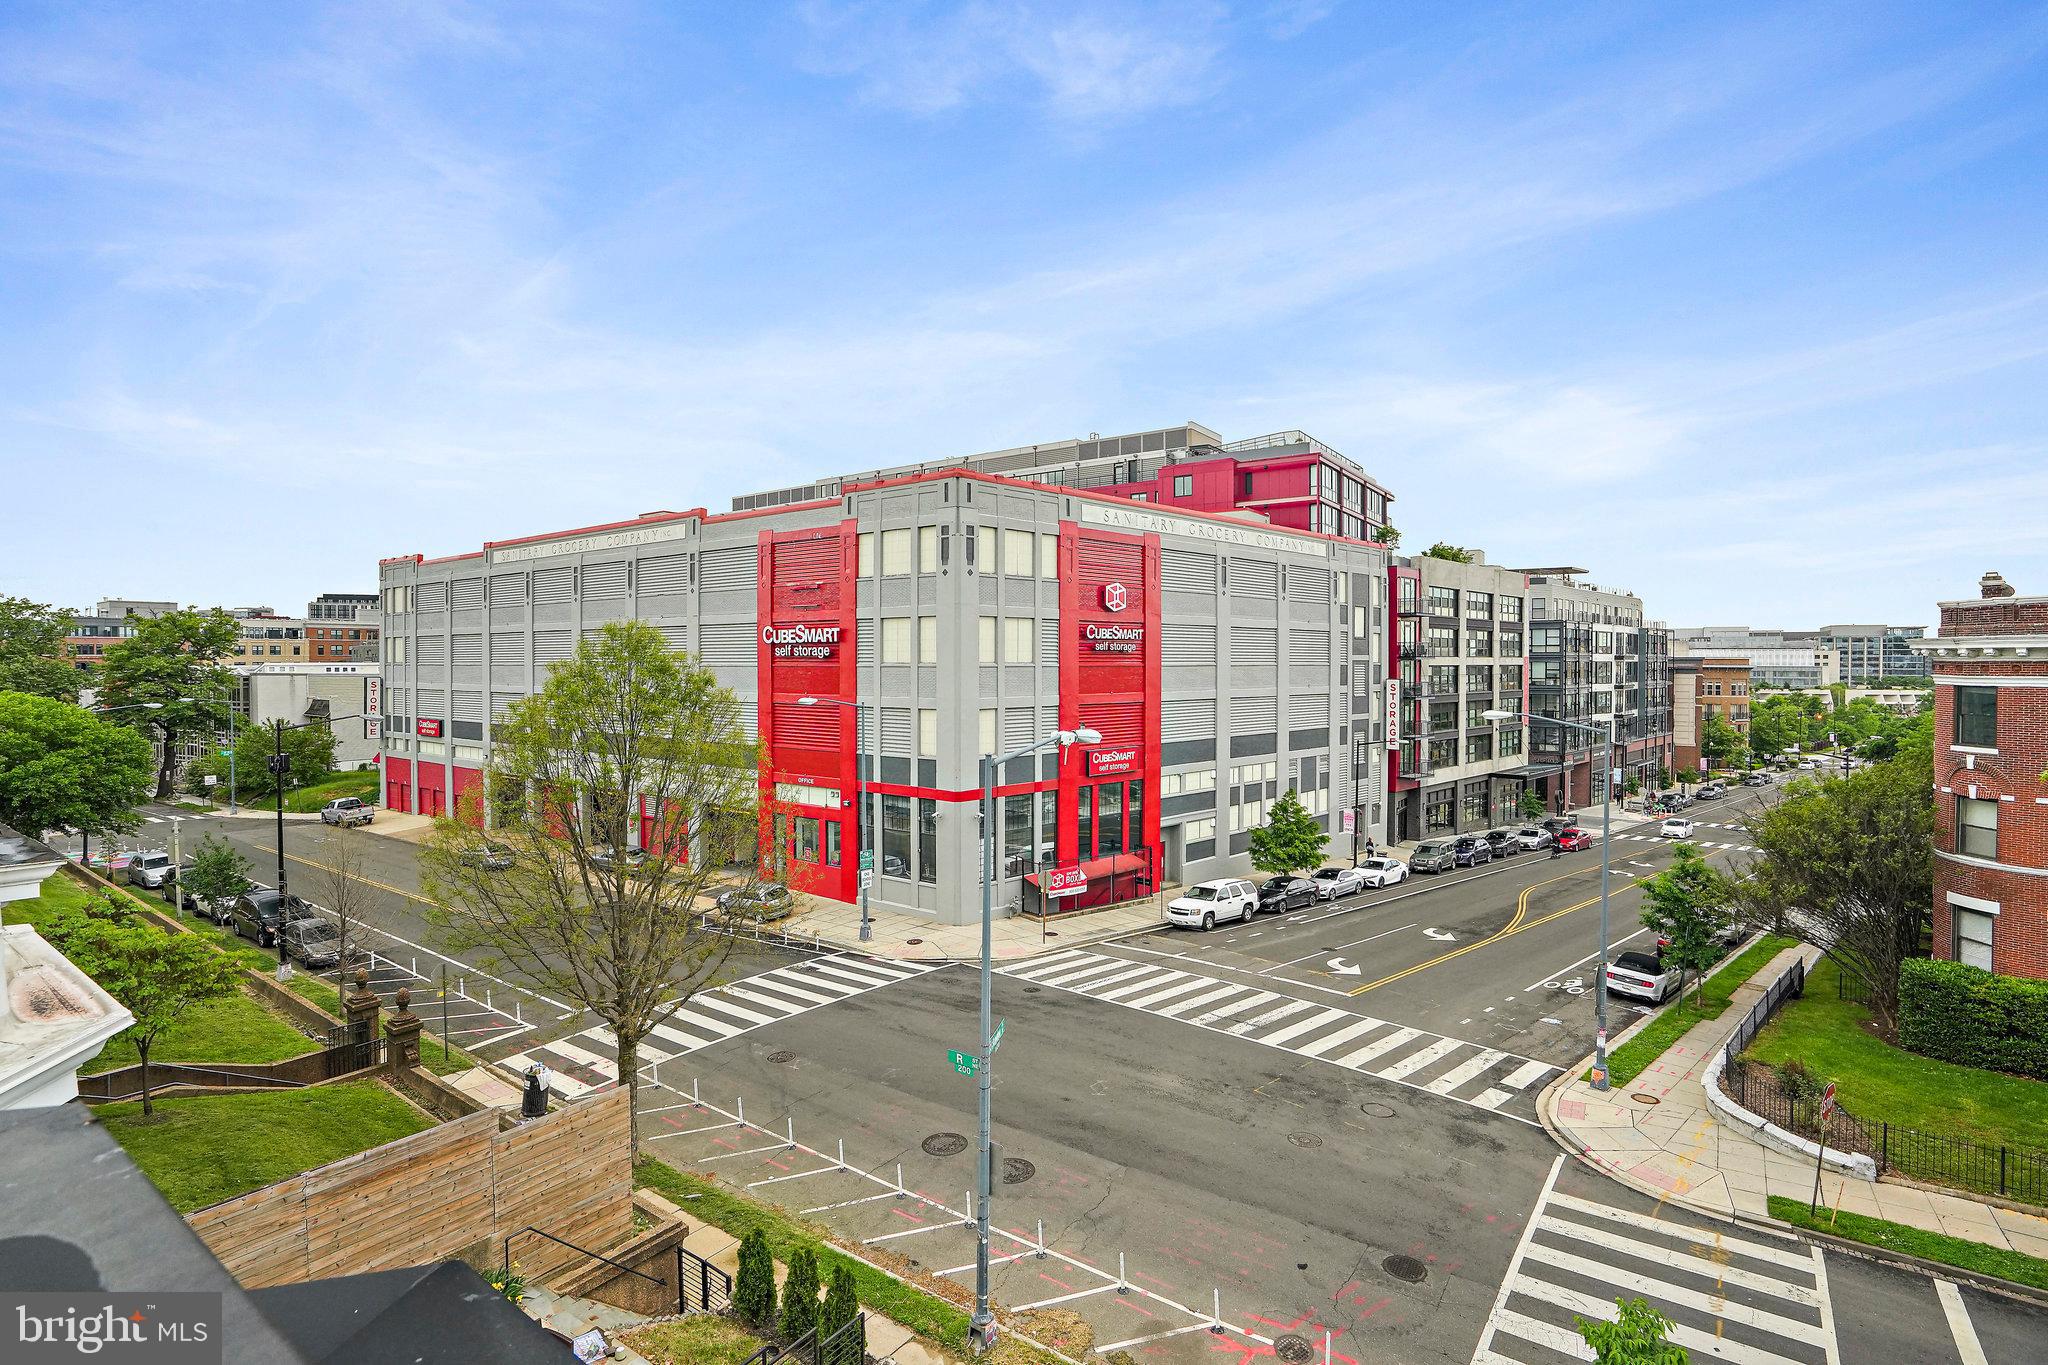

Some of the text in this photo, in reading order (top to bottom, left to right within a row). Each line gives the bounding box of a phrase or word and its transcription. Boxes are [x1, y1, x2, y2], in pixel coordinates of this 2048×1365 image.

[1103, 509, 1176, 532] SANITARY
[1188, 523, 1246, 543] GROCERY
[1256, 534, 1304, 552] COMPANY
[501, 546, 545, 562] SANITARY
[551, 538, 597, 555] GROCERY
[607, 529, 659, 548] COMPANY
[774, 645, 830, 658] self storage
[1095, 641, 1137, 652] self storage
[1389, 683, 1397, 746] STORAGE
[1110, 762, 1130, 771] storage
[797, 777, 814, 785] OFFICE
[956, 1053, 963, 1065] R
[957, 1064, 971, 1075] 200
